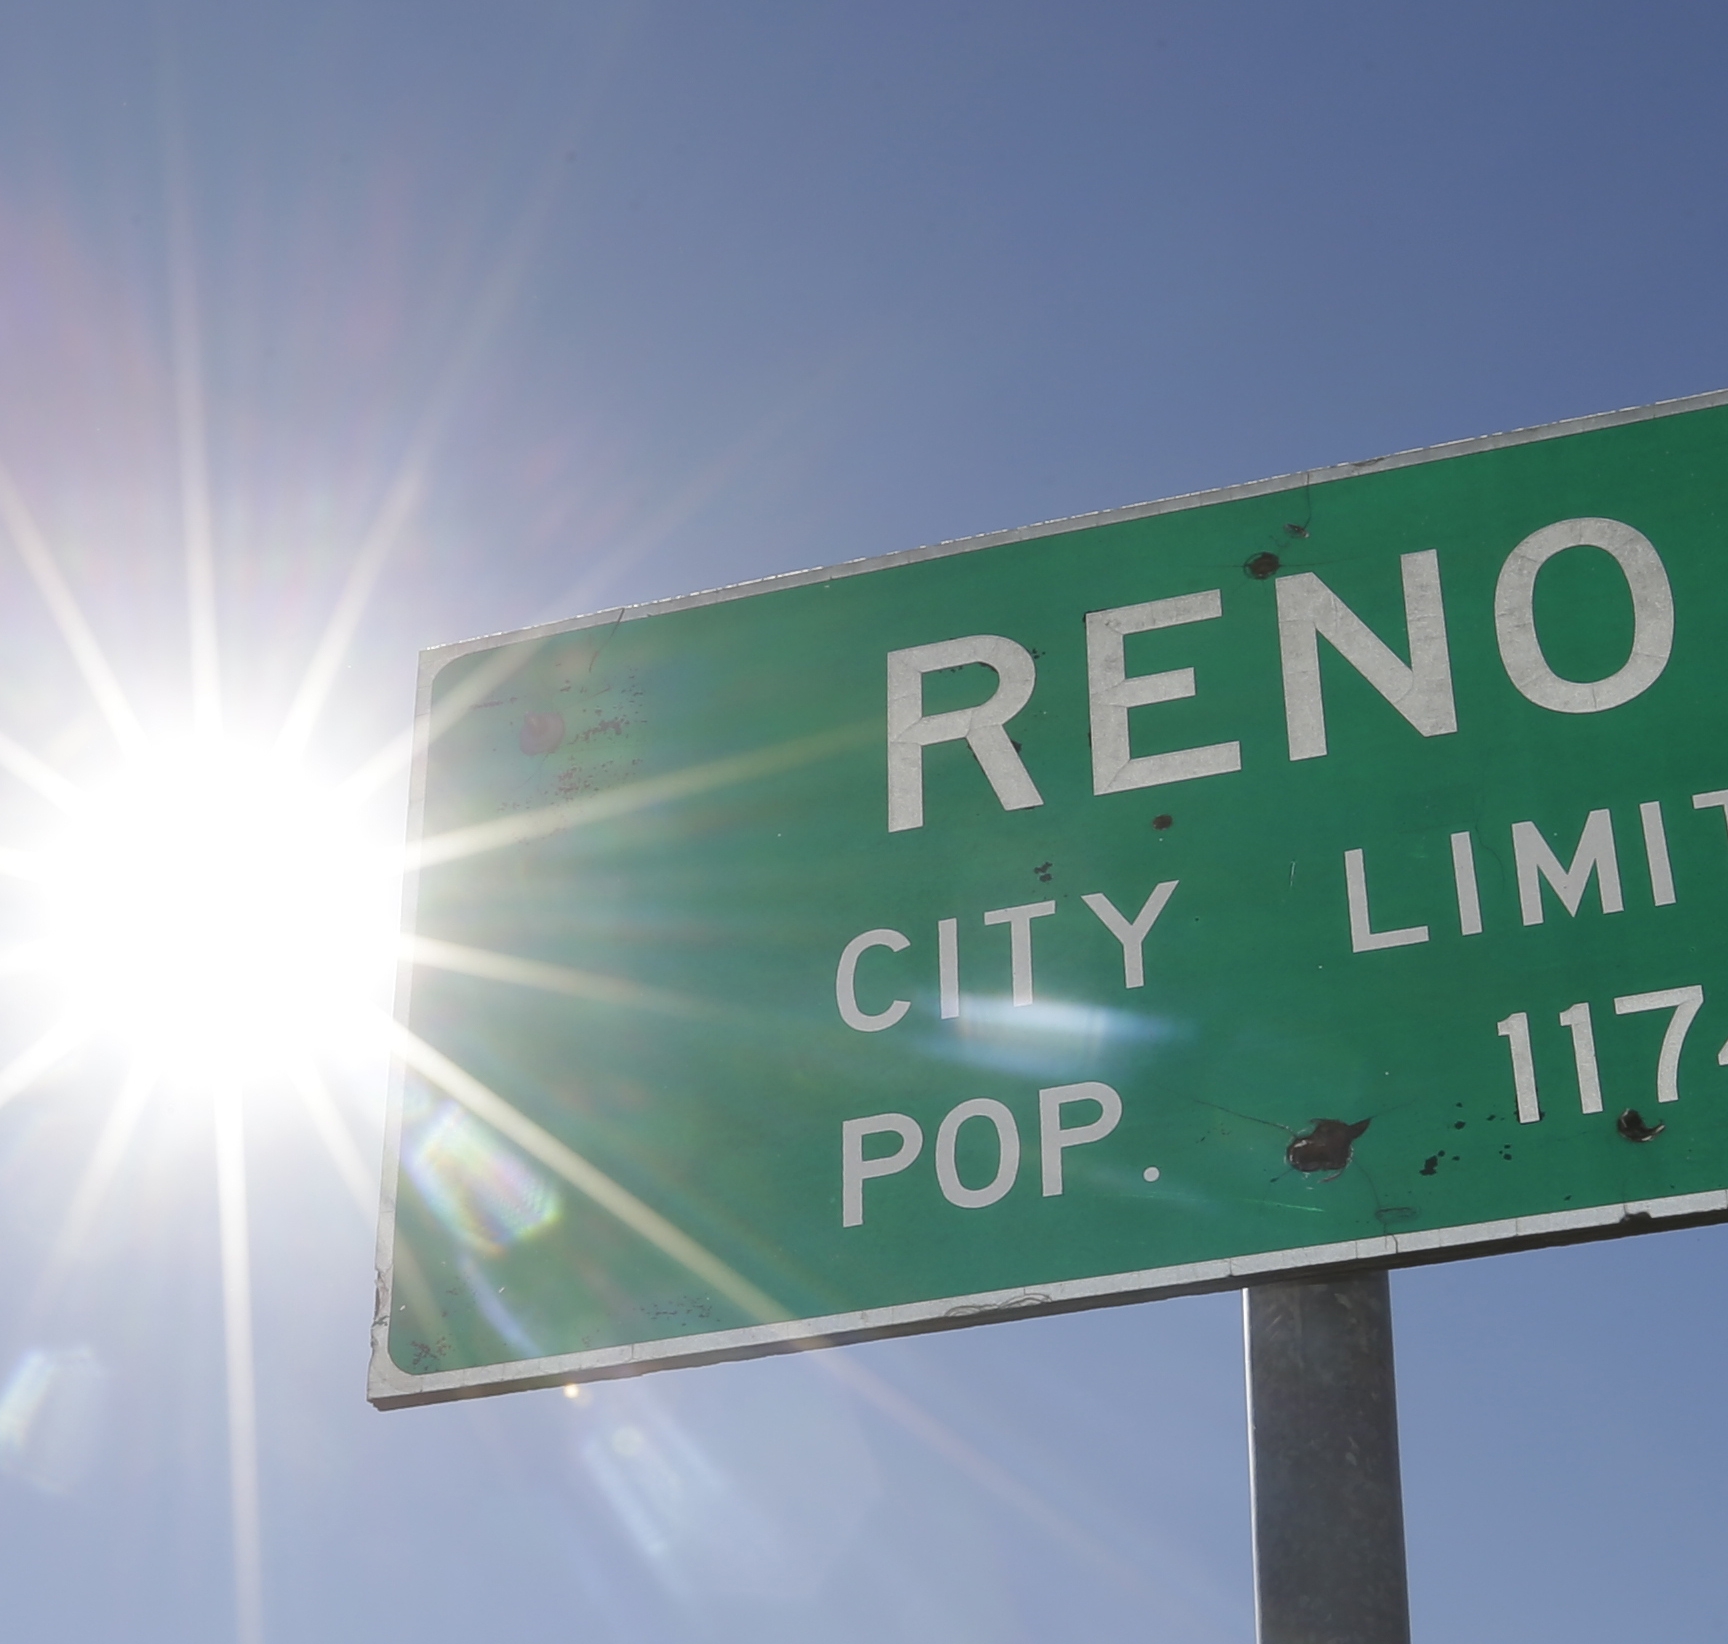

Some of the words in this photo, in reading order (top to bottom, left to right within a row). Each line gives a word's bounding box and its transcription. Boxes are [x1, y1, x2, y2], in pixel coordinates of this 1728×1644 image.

[887, 518, 1675, 832] RENO
[836, 880, 1179, 1032] CITY
[843, 1082, 1160, 1227] POP.
